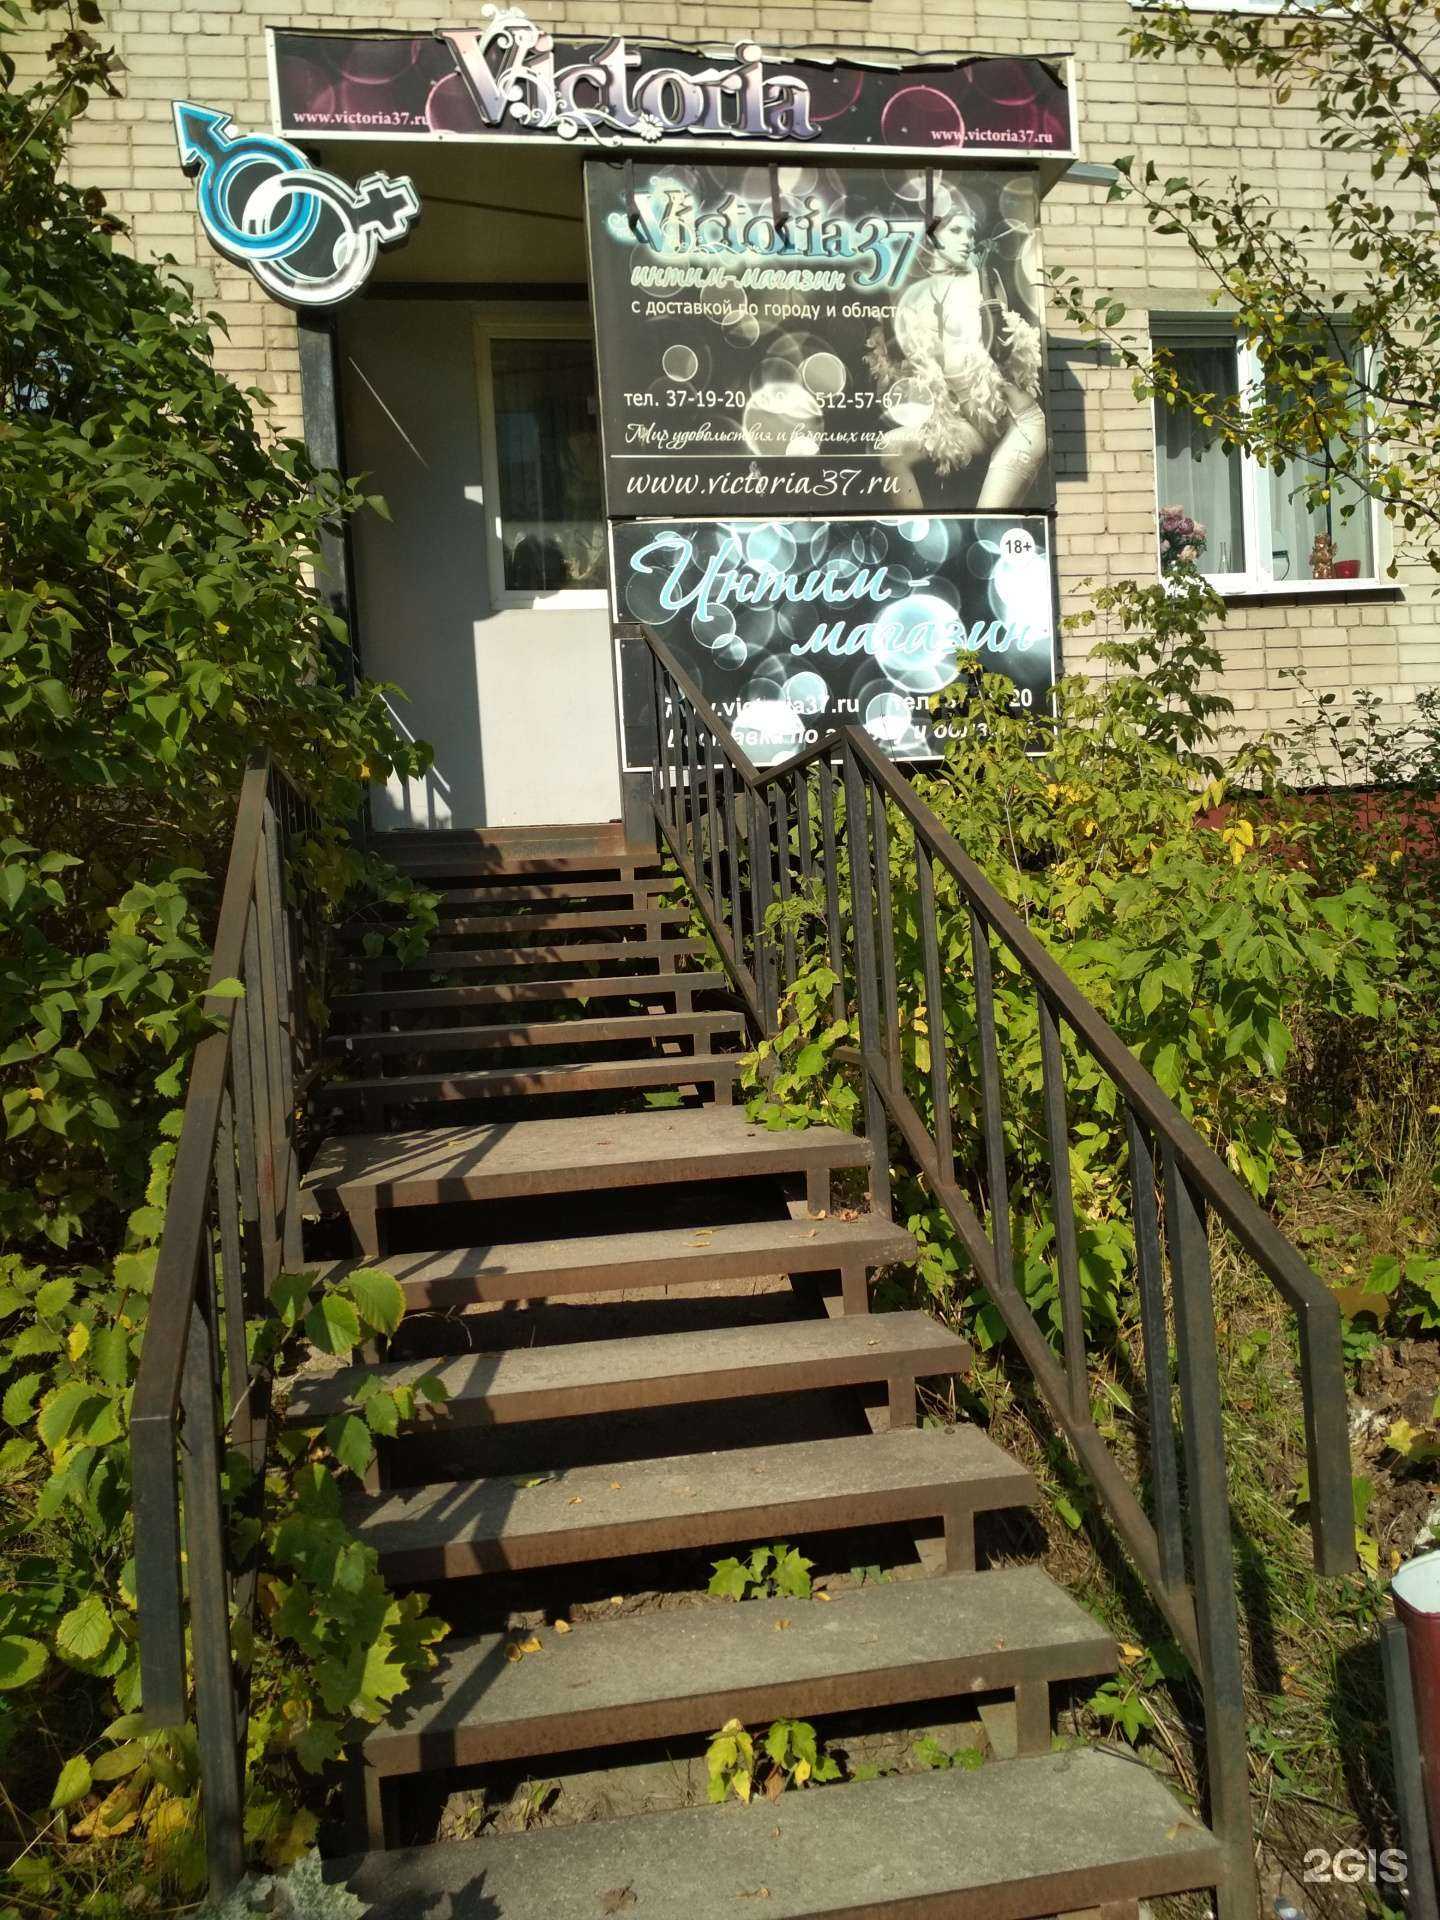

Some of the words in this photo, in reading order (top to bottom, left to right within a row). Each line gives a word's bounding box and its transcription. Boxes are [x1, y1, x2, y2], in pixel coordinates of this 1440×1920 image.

[434, 14, 822, 142] Victoria
[293, 111, 431, 126] www.victoria37.ru
[930, 128, 1053, 143] www.victoria37.ru
[630, 265, 846, 292] интим-магазин
[631, 302, 640, 313] с
[645, 300, 732, 316] доставкой
[739, 303, 758, 315] по
[765, 303, 820, 320] городу
[827, 306, 836, 317] и
[842, 302, 901, 319] област
[623, 392, 660, 407] тел.
[666, 390, 746, 408] 37-19-20
[625, 421, 669, 450] Мир
[776, 432, 787, 441] и
[626, 468, 901, 496] www.victoria37.ru
[1005, 539, 1032, 554] 18+
[630, 537, 893, 622] Интим
